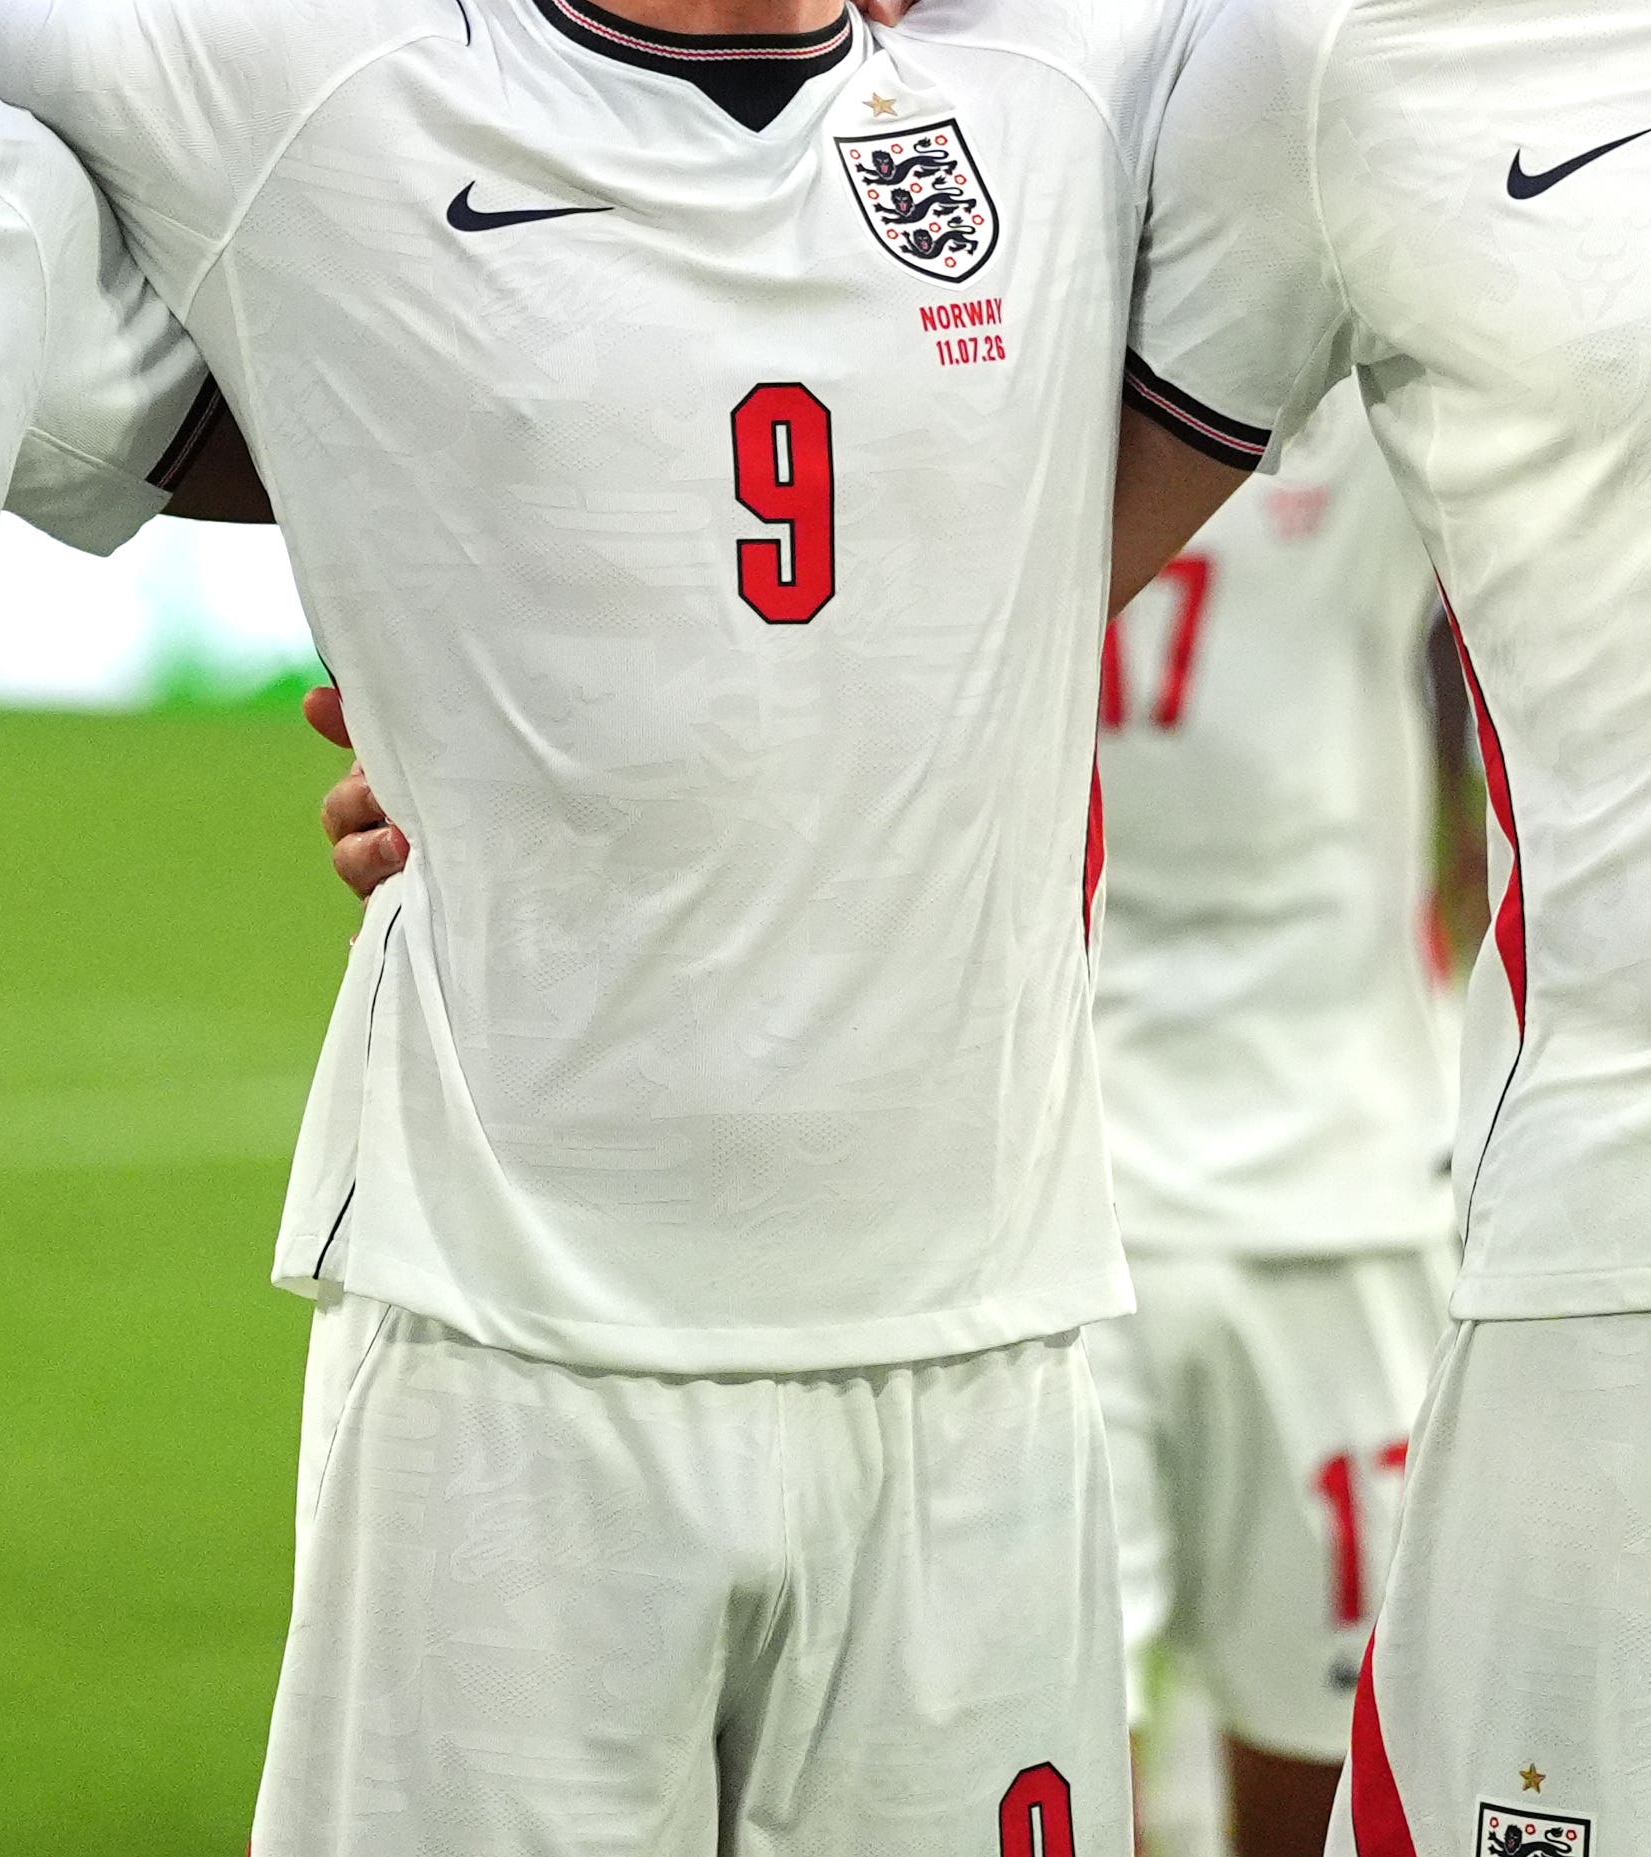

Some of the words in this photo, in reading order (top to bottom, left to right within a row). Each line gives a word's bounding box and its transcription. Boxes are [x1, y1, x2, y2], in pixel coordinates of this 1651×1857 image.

[919, 297, 1003, 333] NORWAY
[936, 334, 1006, 367] 11.07.26
[731, 383, 835, 624] 9
[1312, 1438, 1410, 1627] 1
